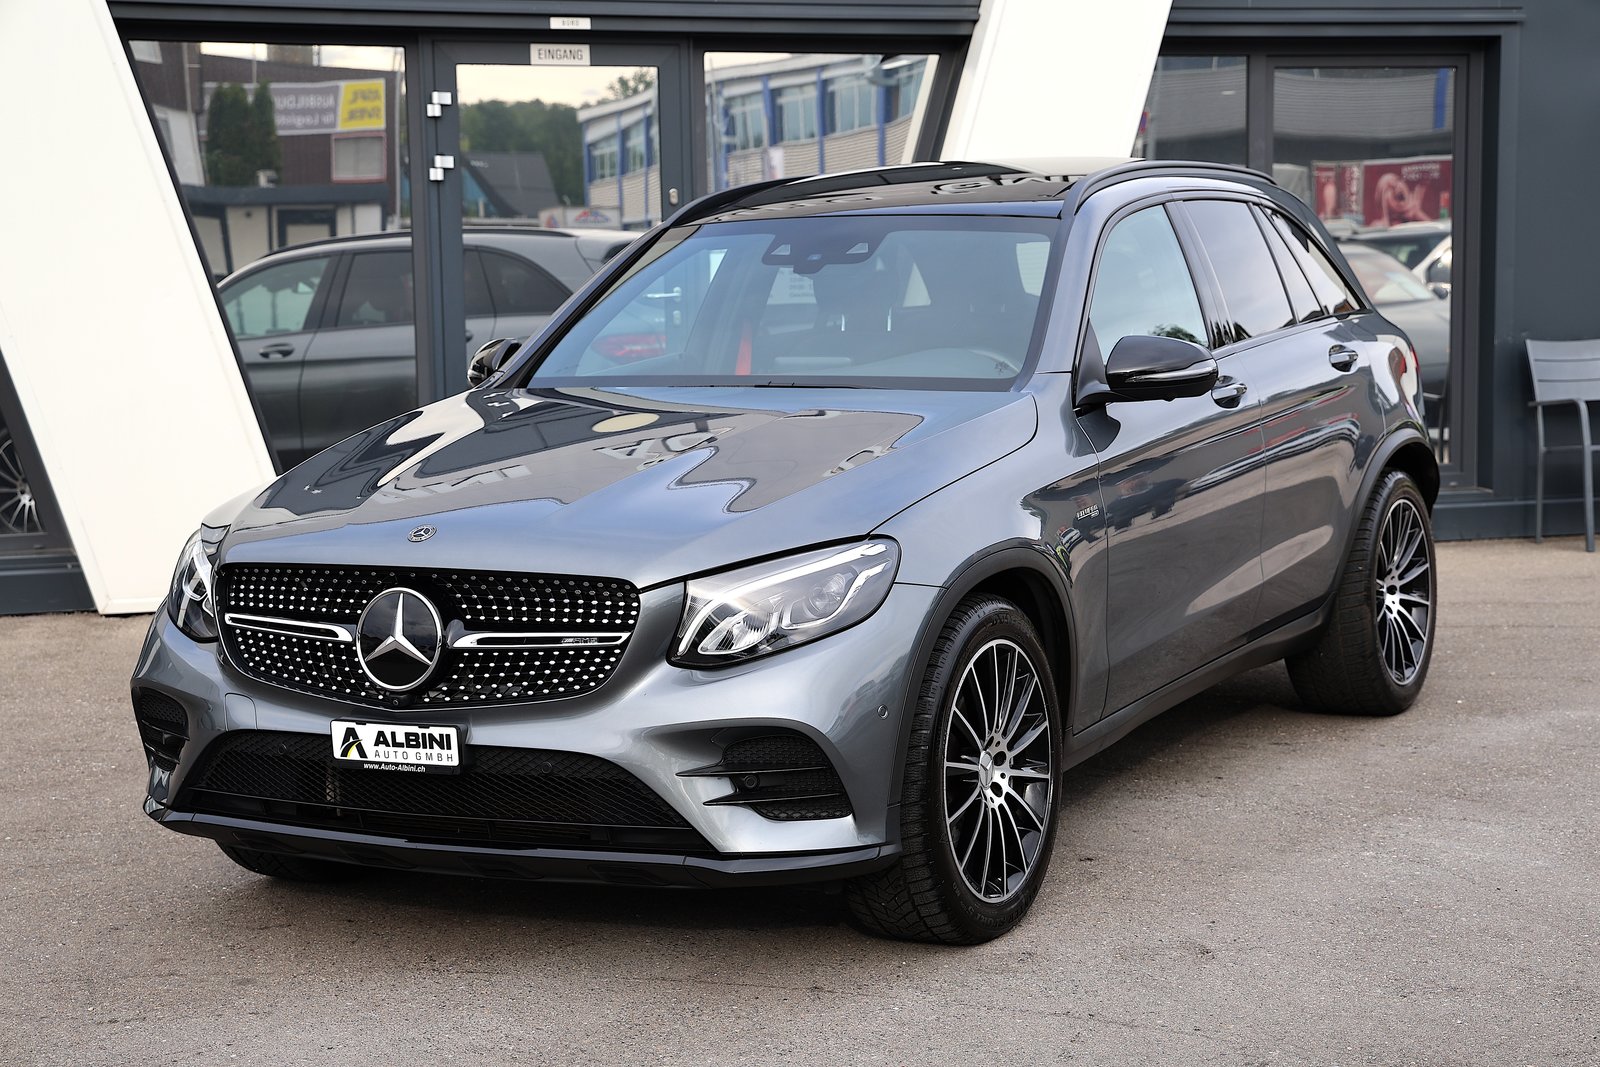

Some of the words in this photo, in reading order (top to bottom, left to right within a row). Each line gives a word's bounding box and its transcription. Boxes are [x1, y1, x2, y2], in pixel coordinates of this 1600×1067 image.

[537, 47, 584, 61] EINGANG
[374, 730, 452, 750] ALBINI
[374, 749, 409, 760] AUTO
[415, 751, 454, 762] GMBH
[363, 762, 426, 773] www.Auto-Albini.ch
